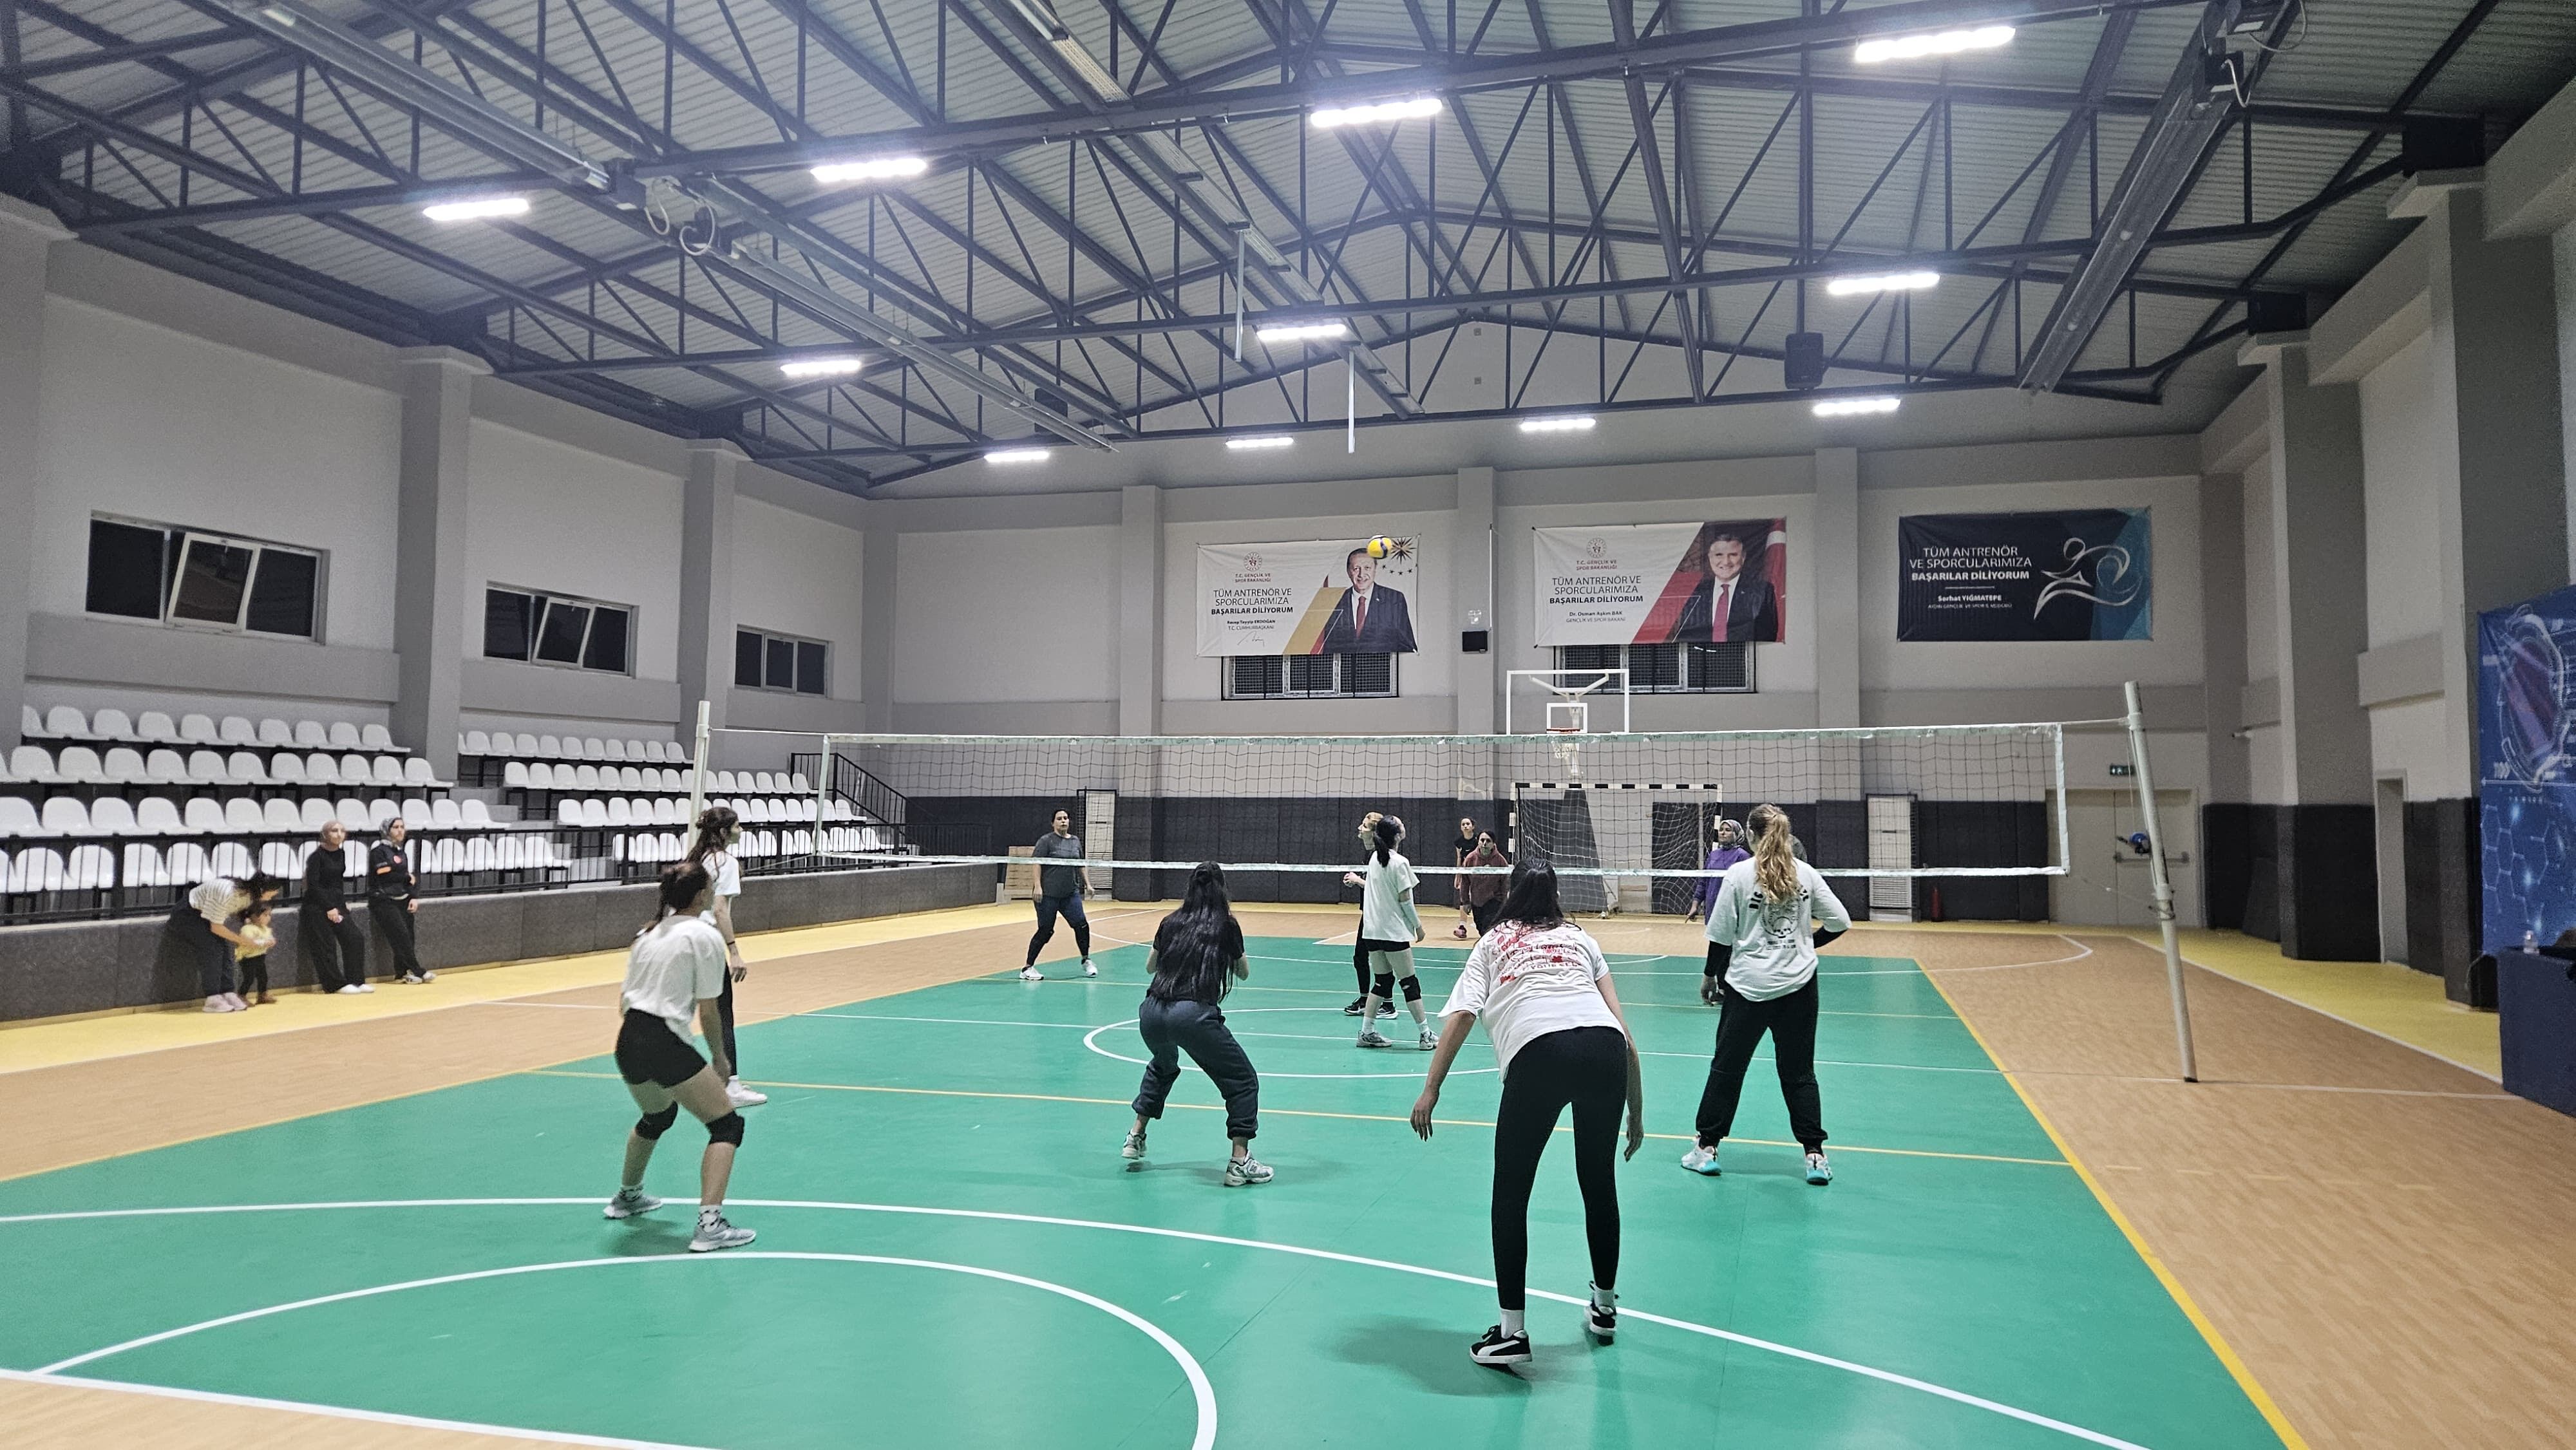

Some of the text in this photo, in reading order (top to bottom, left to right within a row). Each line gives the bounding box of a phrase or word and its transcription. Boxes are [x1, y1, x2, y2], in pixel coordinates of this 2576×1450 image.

[1923, 545, 2018, 557] TÜM ANTRENÖR
[1909, 557, 2032, 569] VE SPORCULARIMIZA
[1552, 575, 1642, 585] TÜM ANTRENÖR VE
[1911, 570, 2030, 583] BAŞARILAR DİLİYORUM
[1213, 588, 1292, 598] TÜM ANTRENÖR VE
[1554, 585, 1638, 594] SPORCULARIMIZA
[1215, 597, 1289, 606] SPORCULARIMIZA
[1549, 595, 1643, 605] BAŞARILAR DİLİYORUM
